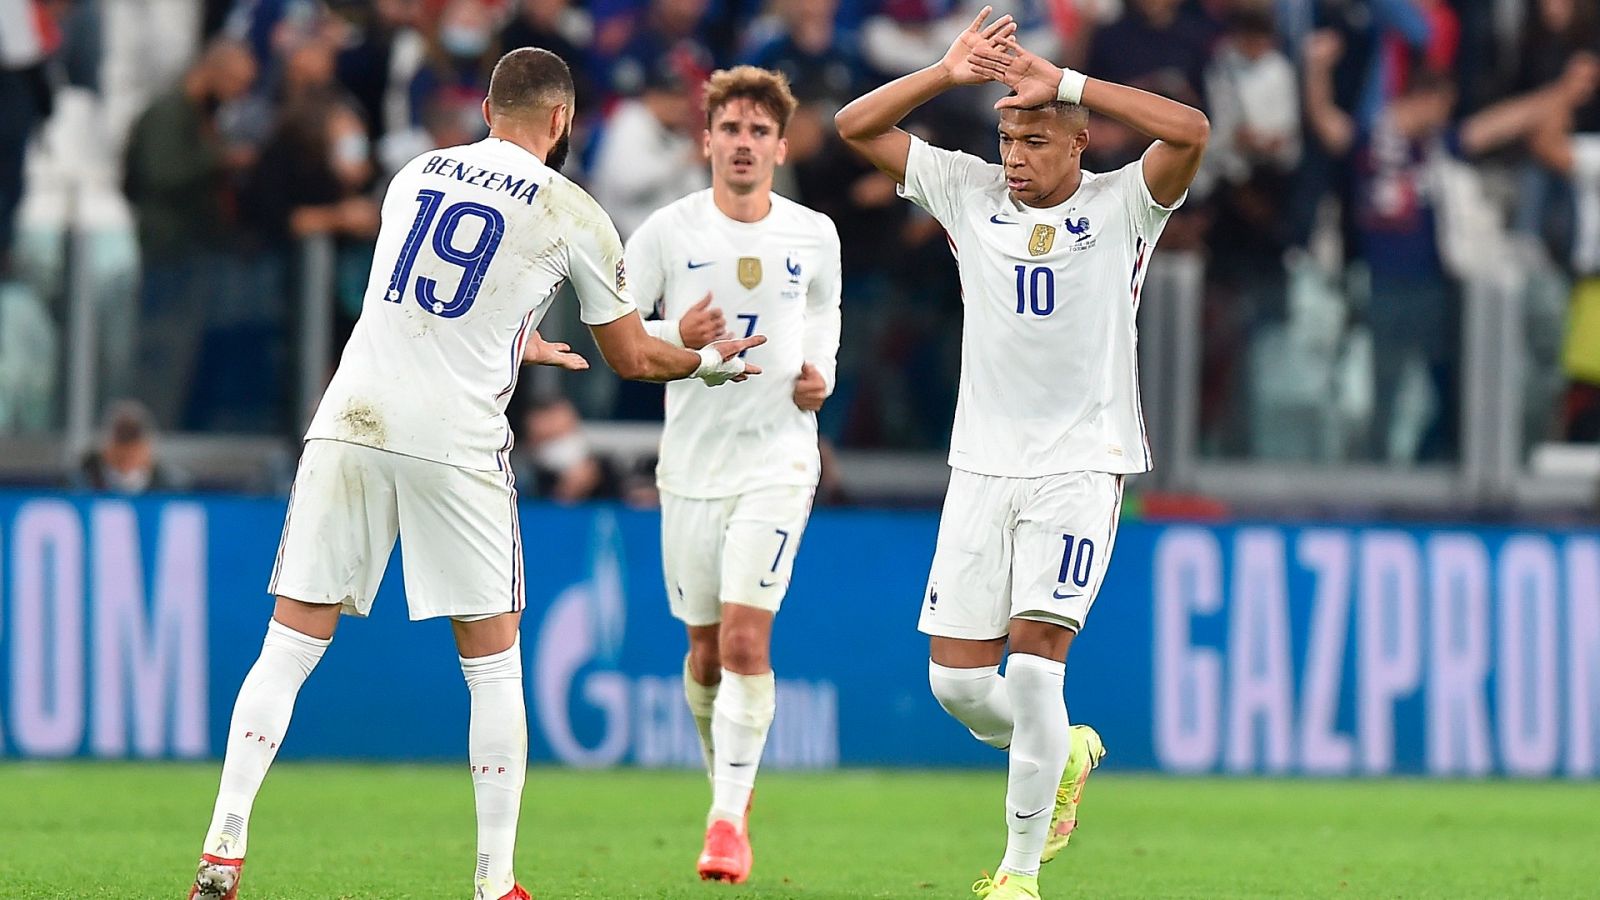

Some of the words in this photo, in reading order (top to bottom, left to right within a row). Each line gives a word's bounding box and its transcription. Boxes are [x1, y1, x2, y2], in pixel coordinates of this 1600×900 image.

[422, 155, 540, 206] BENZEMA
[383, 188, 506, 319] 19
[1014, 264, 1055, 316] 10
[737, 314, 759, 358] 7
[771, 529, 789, 573] 7
[1057, 533, 1095, 588] 10
[0, 497, 210, 759] OM
